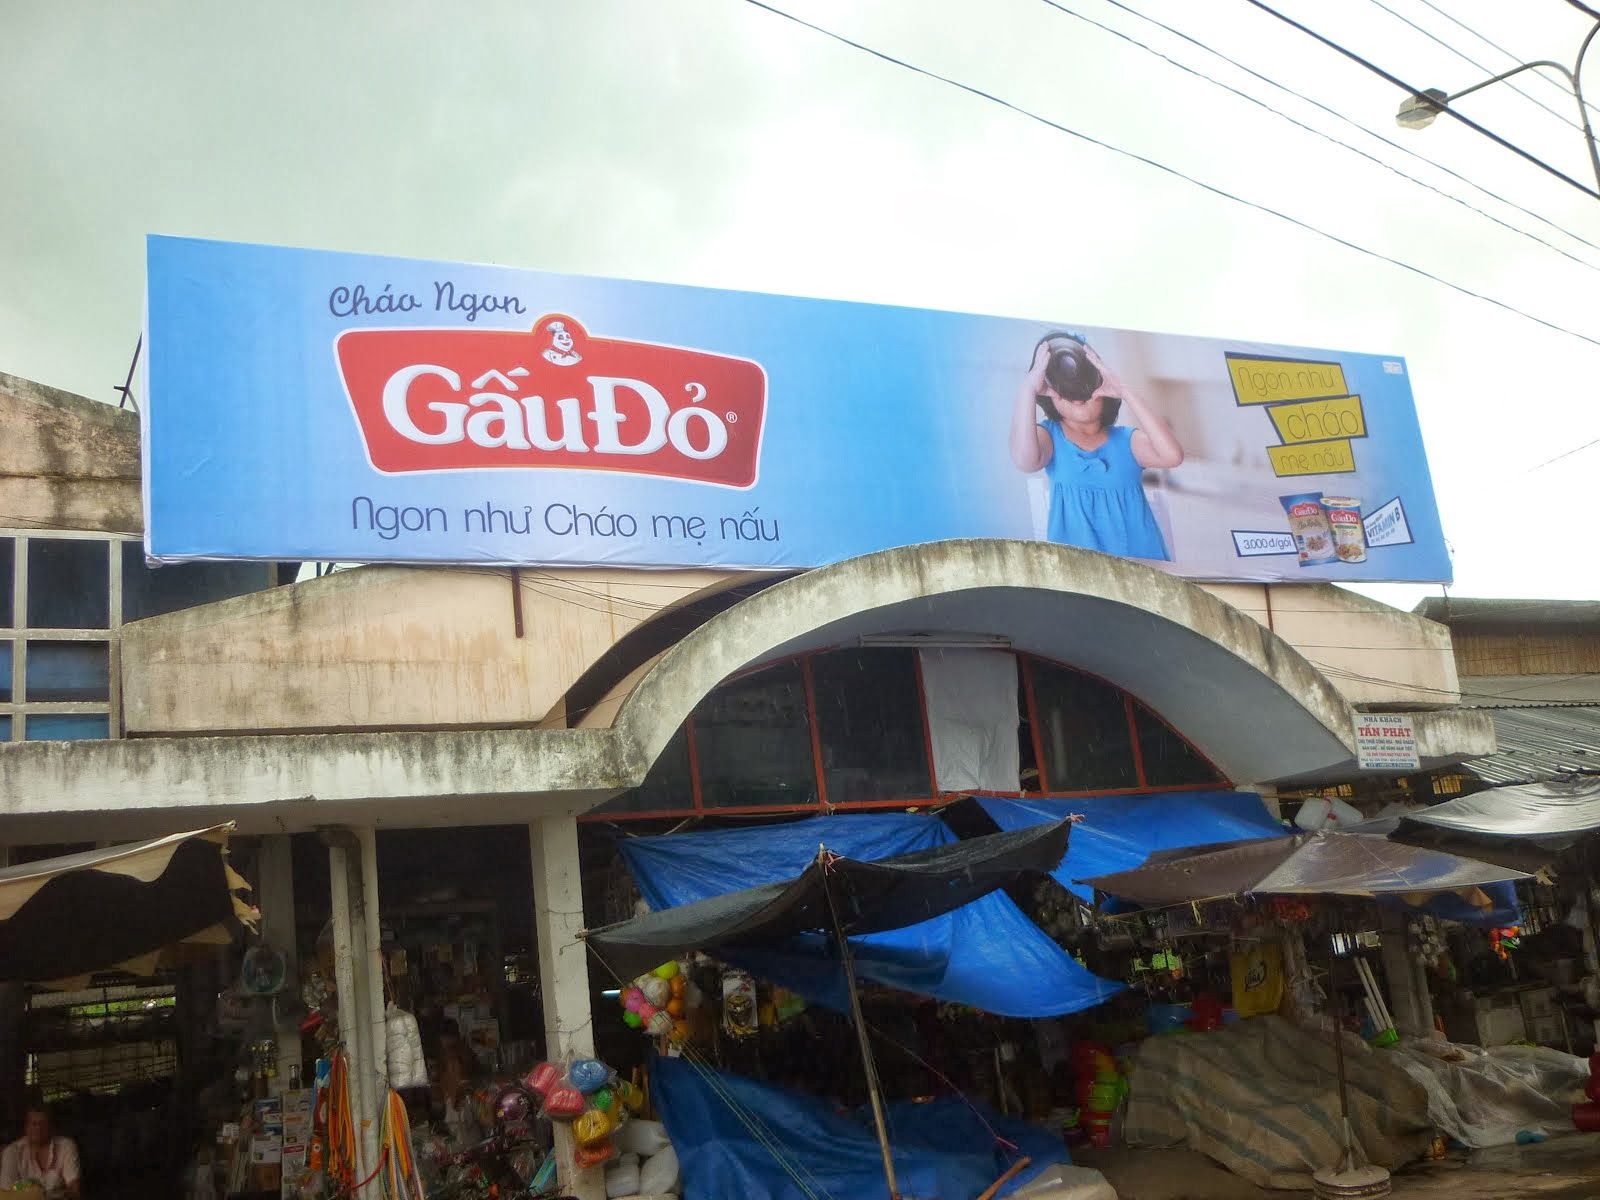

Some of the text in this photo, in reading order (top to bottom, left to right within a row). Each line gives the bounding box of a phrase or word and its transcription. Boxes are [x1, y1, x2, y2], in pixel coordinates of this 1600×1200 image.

[330, 280, 527, 323] Cháo Ngon
[1286, 402, 1359, 440] cháo
[352, 495, 781, 547] Ngon như Cháo mẹ nấu
[1366, 510, 1396, 538] VITAMIN
[1394, 506, 1401, 521] B
[1382, 724, 1412, 738] PHÁT
